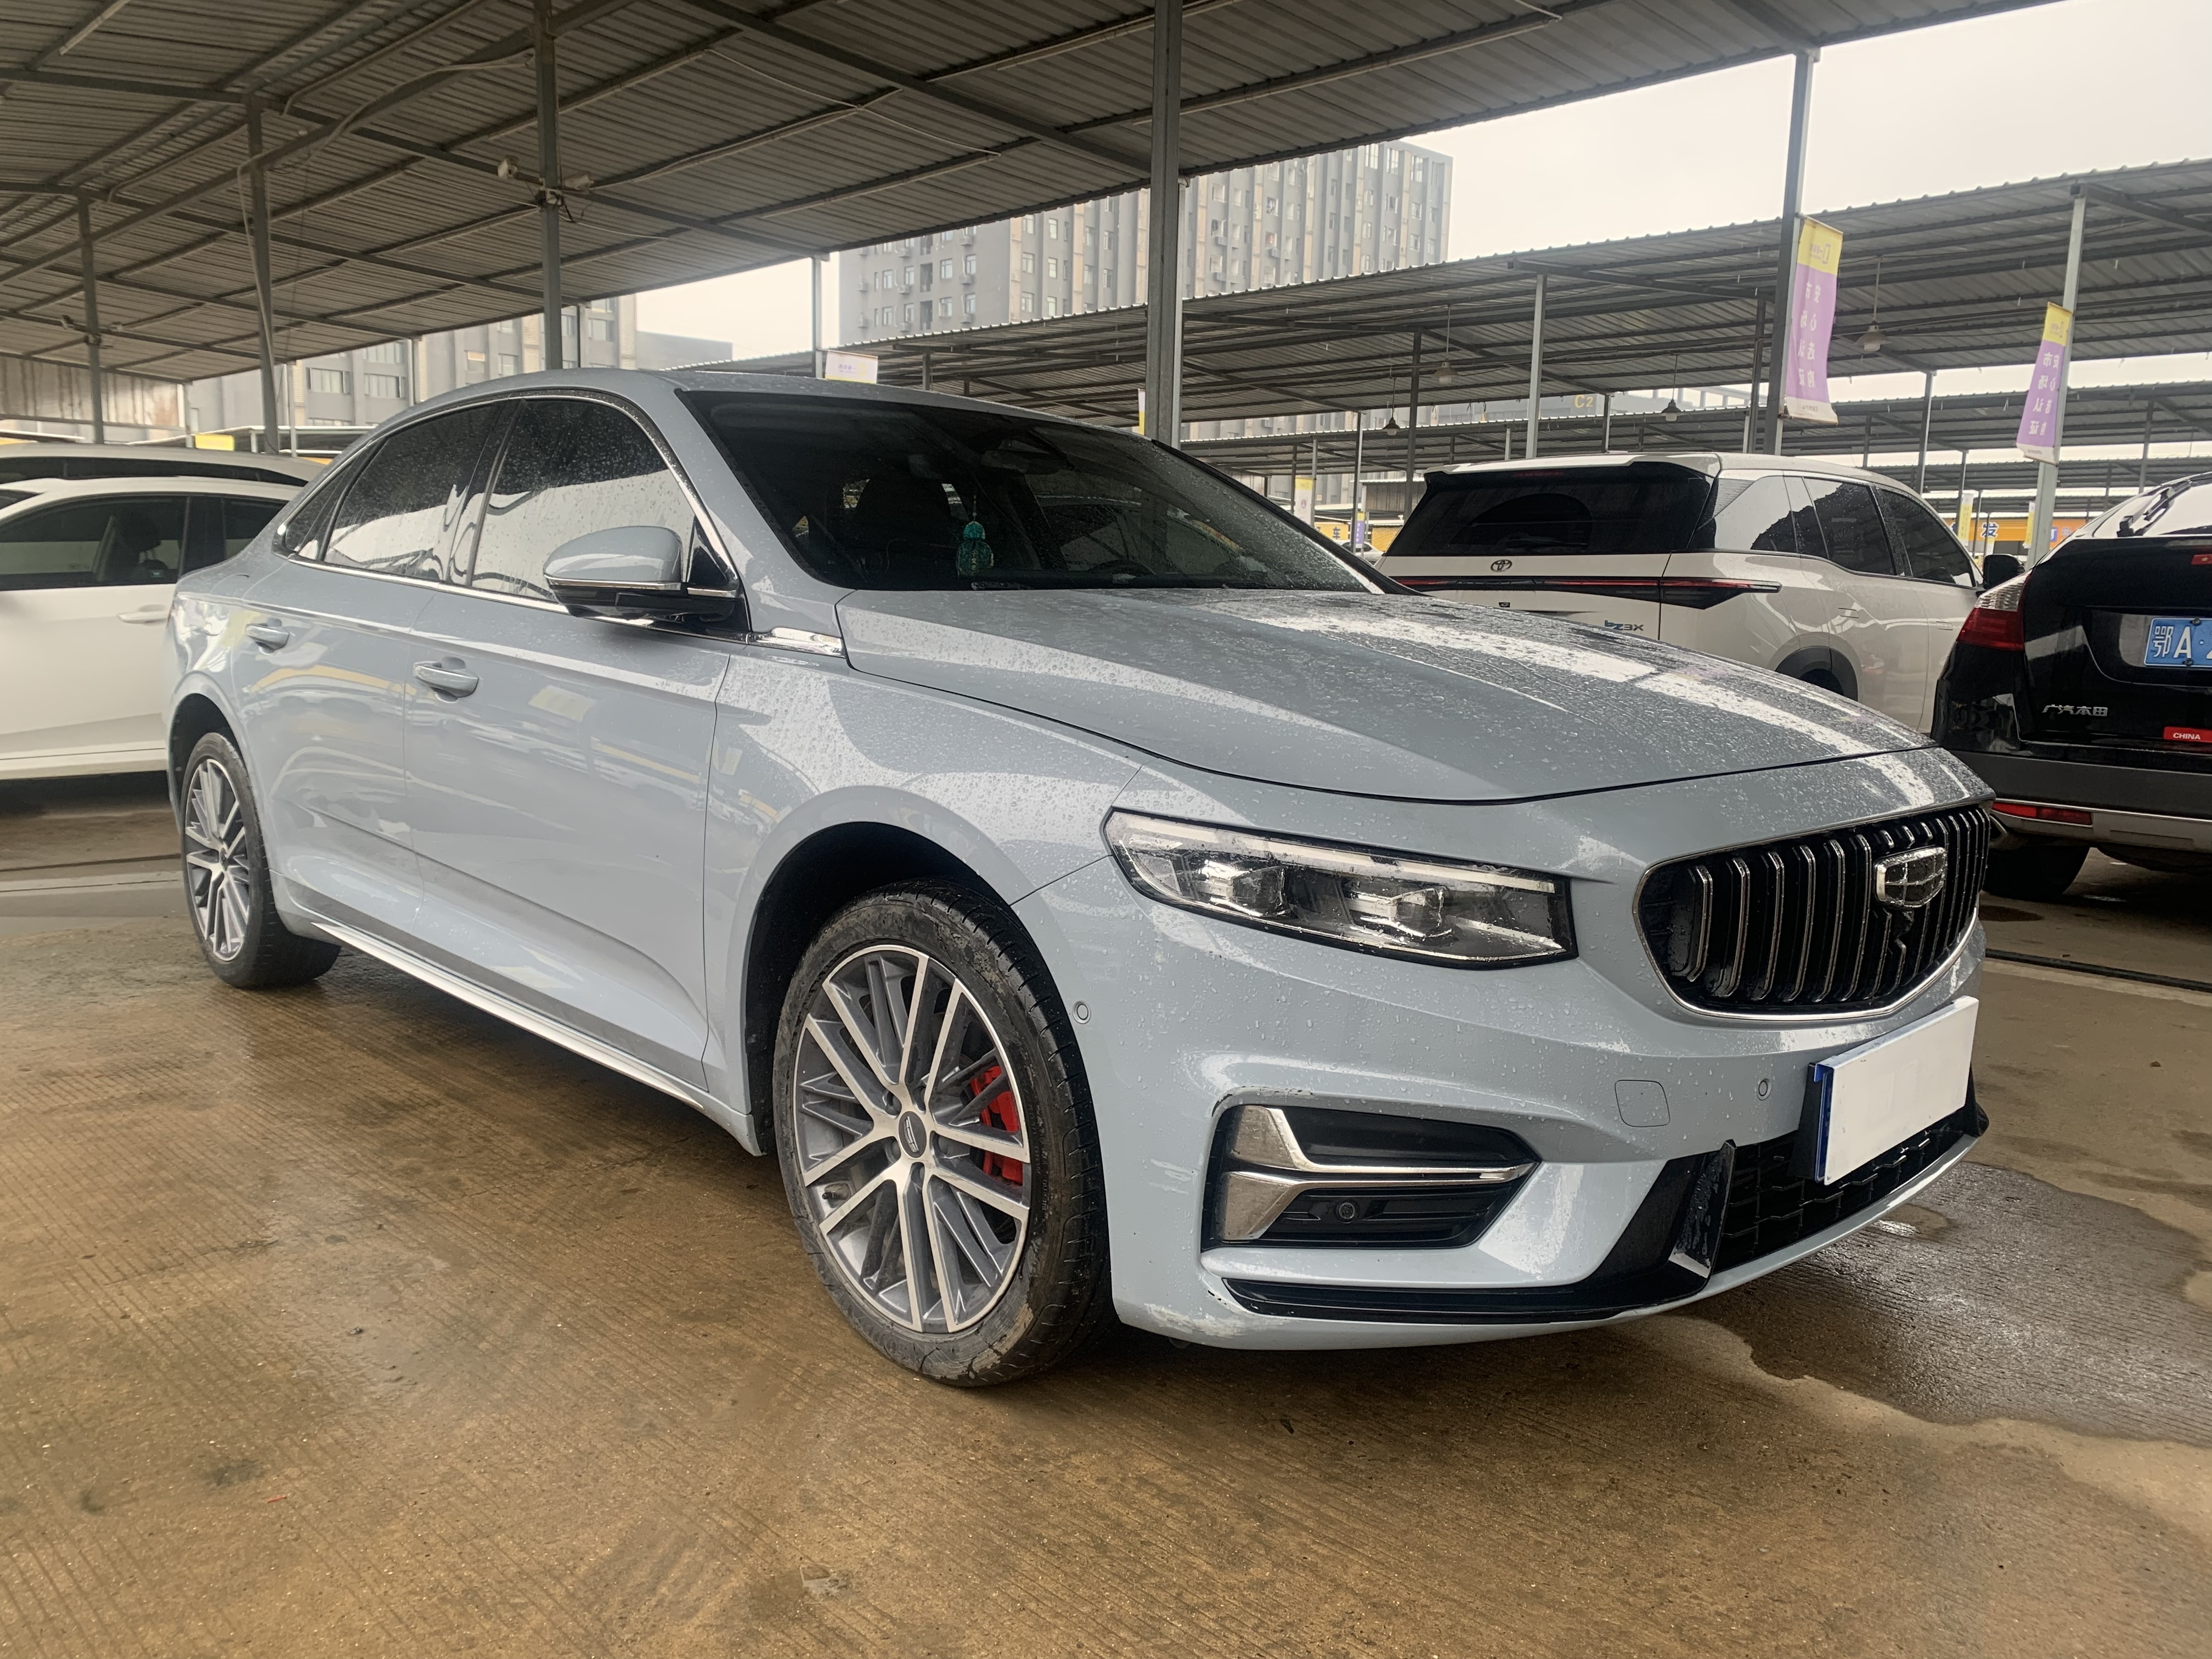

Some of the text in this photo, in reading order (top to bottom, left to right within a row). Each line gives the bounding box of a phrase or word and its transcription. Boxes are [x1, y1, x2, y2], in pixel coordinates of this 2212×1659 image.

[2041, 704, 2108, 716] 广汽本田
[2173, 732, 2201, 740] CHINA
